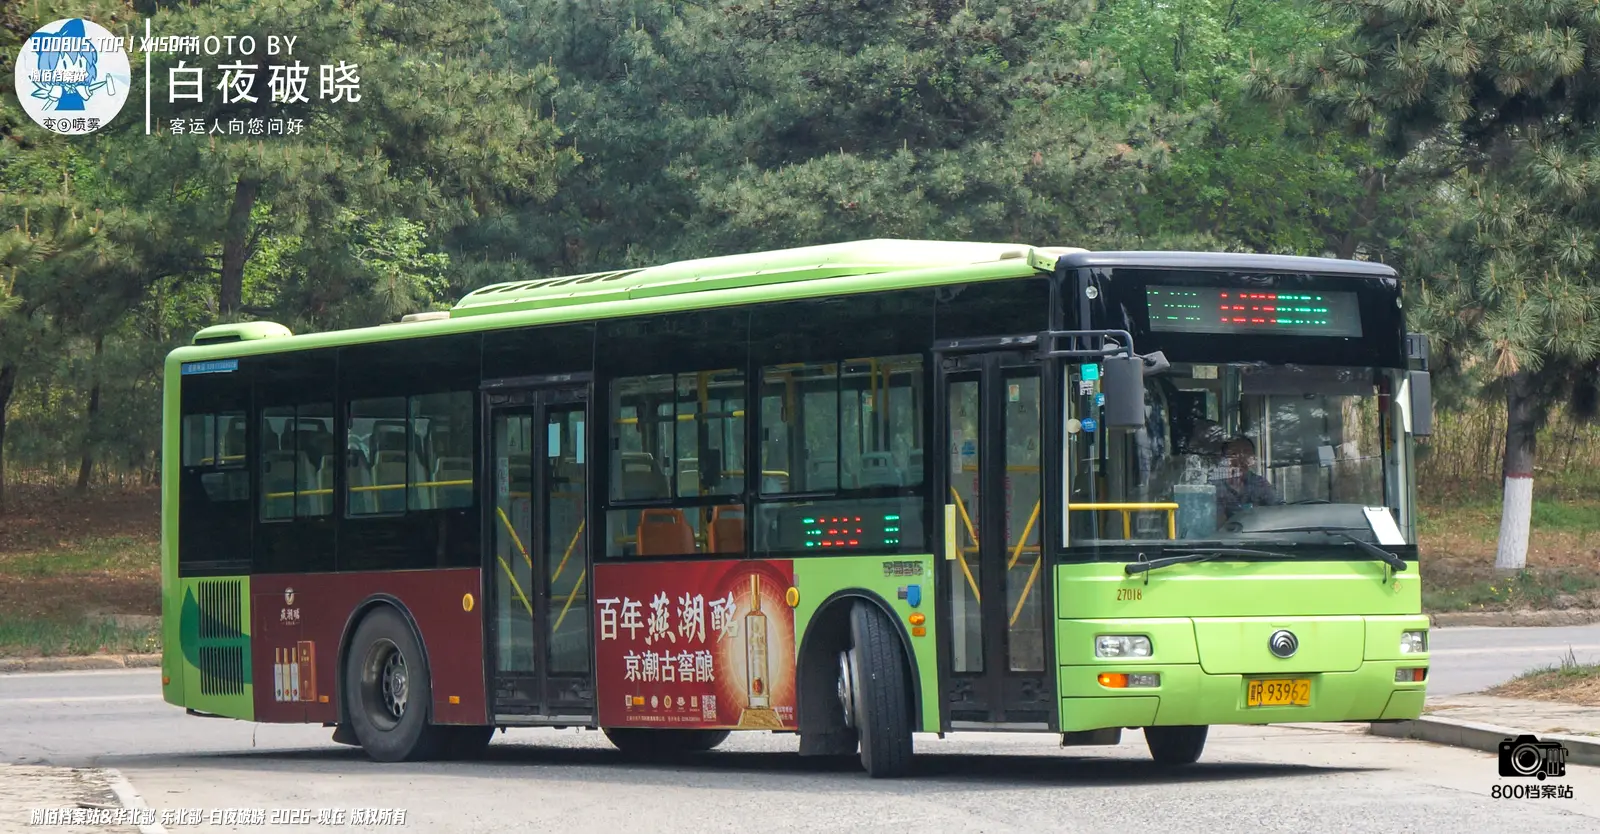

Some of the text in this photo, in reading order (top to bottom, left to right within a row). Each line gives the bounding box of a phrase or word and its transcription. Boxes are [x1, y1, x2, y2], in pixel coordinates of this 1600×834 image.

[1117, 588, 1142, 601] 27018
[623, 649, 716, 682] 京潮古窖酿
